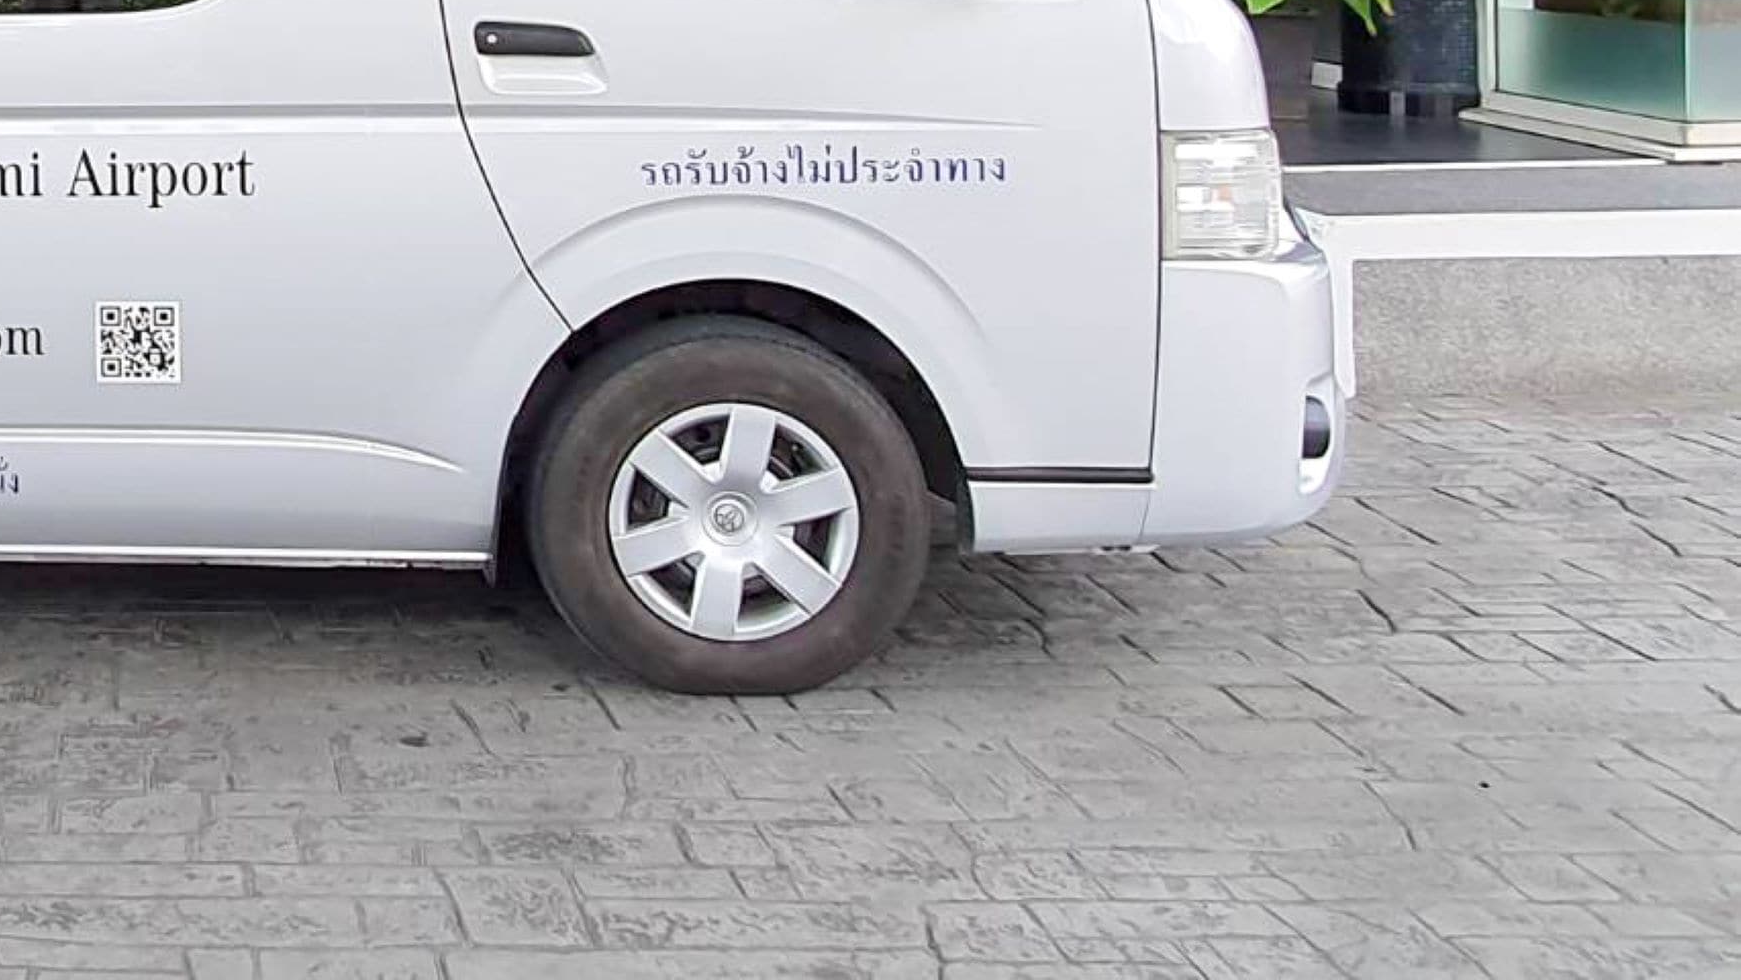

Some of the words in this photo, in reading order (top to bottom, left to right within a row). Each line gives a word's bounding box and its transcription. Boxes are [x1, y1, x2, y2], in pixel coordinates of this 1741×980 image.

[66, 148, 255, 209] Airport
[641, 144, 1005, 186] รถรับจ้างไม่ประจำทาง
